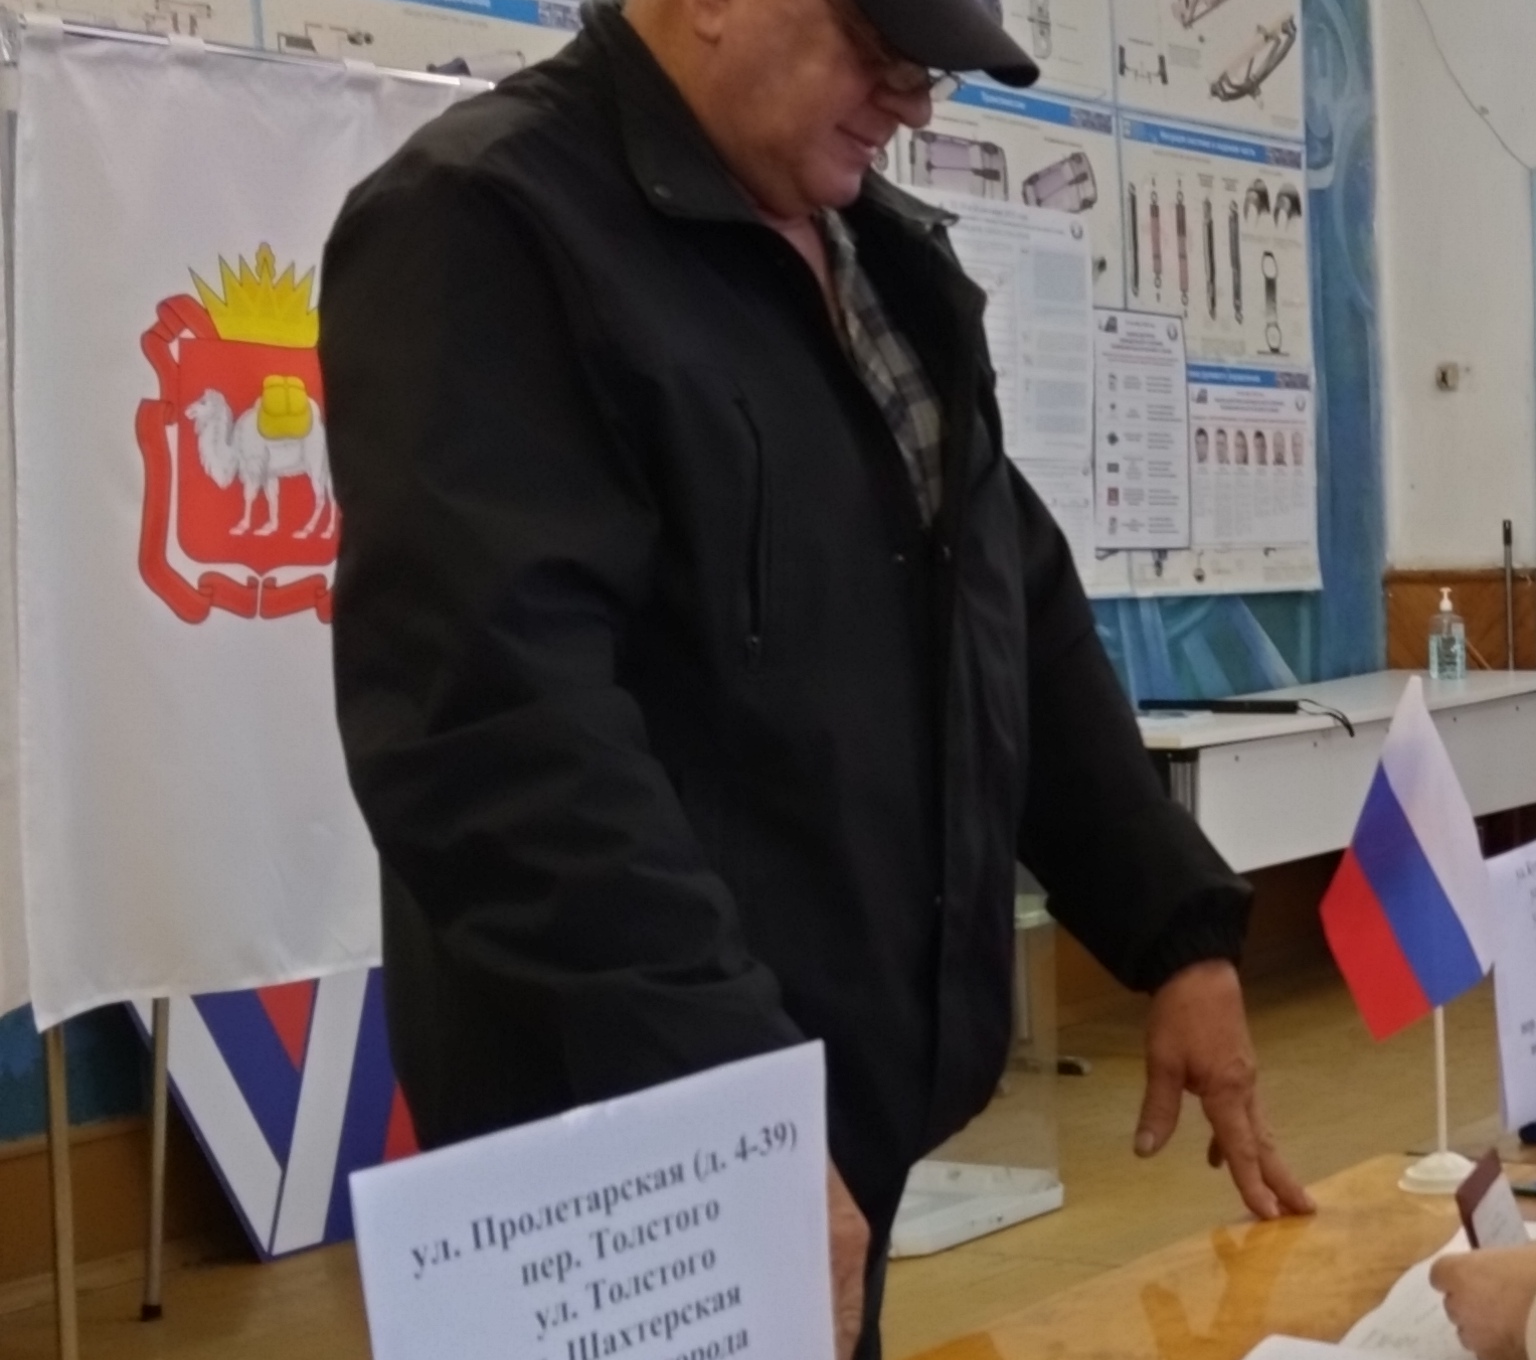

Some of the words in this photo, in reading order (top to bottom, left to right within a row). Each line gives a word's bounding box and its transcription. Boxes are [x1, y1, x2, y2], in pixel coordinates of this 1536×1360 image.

[411, 1238, 461, 1280] ул.
[471, 1162, 685, 1252] Пролетарская
[693, 1151, 728, 1182] (д.
[734, 1121, 798, 1162] 4-39)
[521, 1250, 581, 1287] пер.
[588, 1199, 721, 1260] Толстого
[535, 1300, 579, 1342] ул.
[584, 1248, 717, 1311] Толстого
